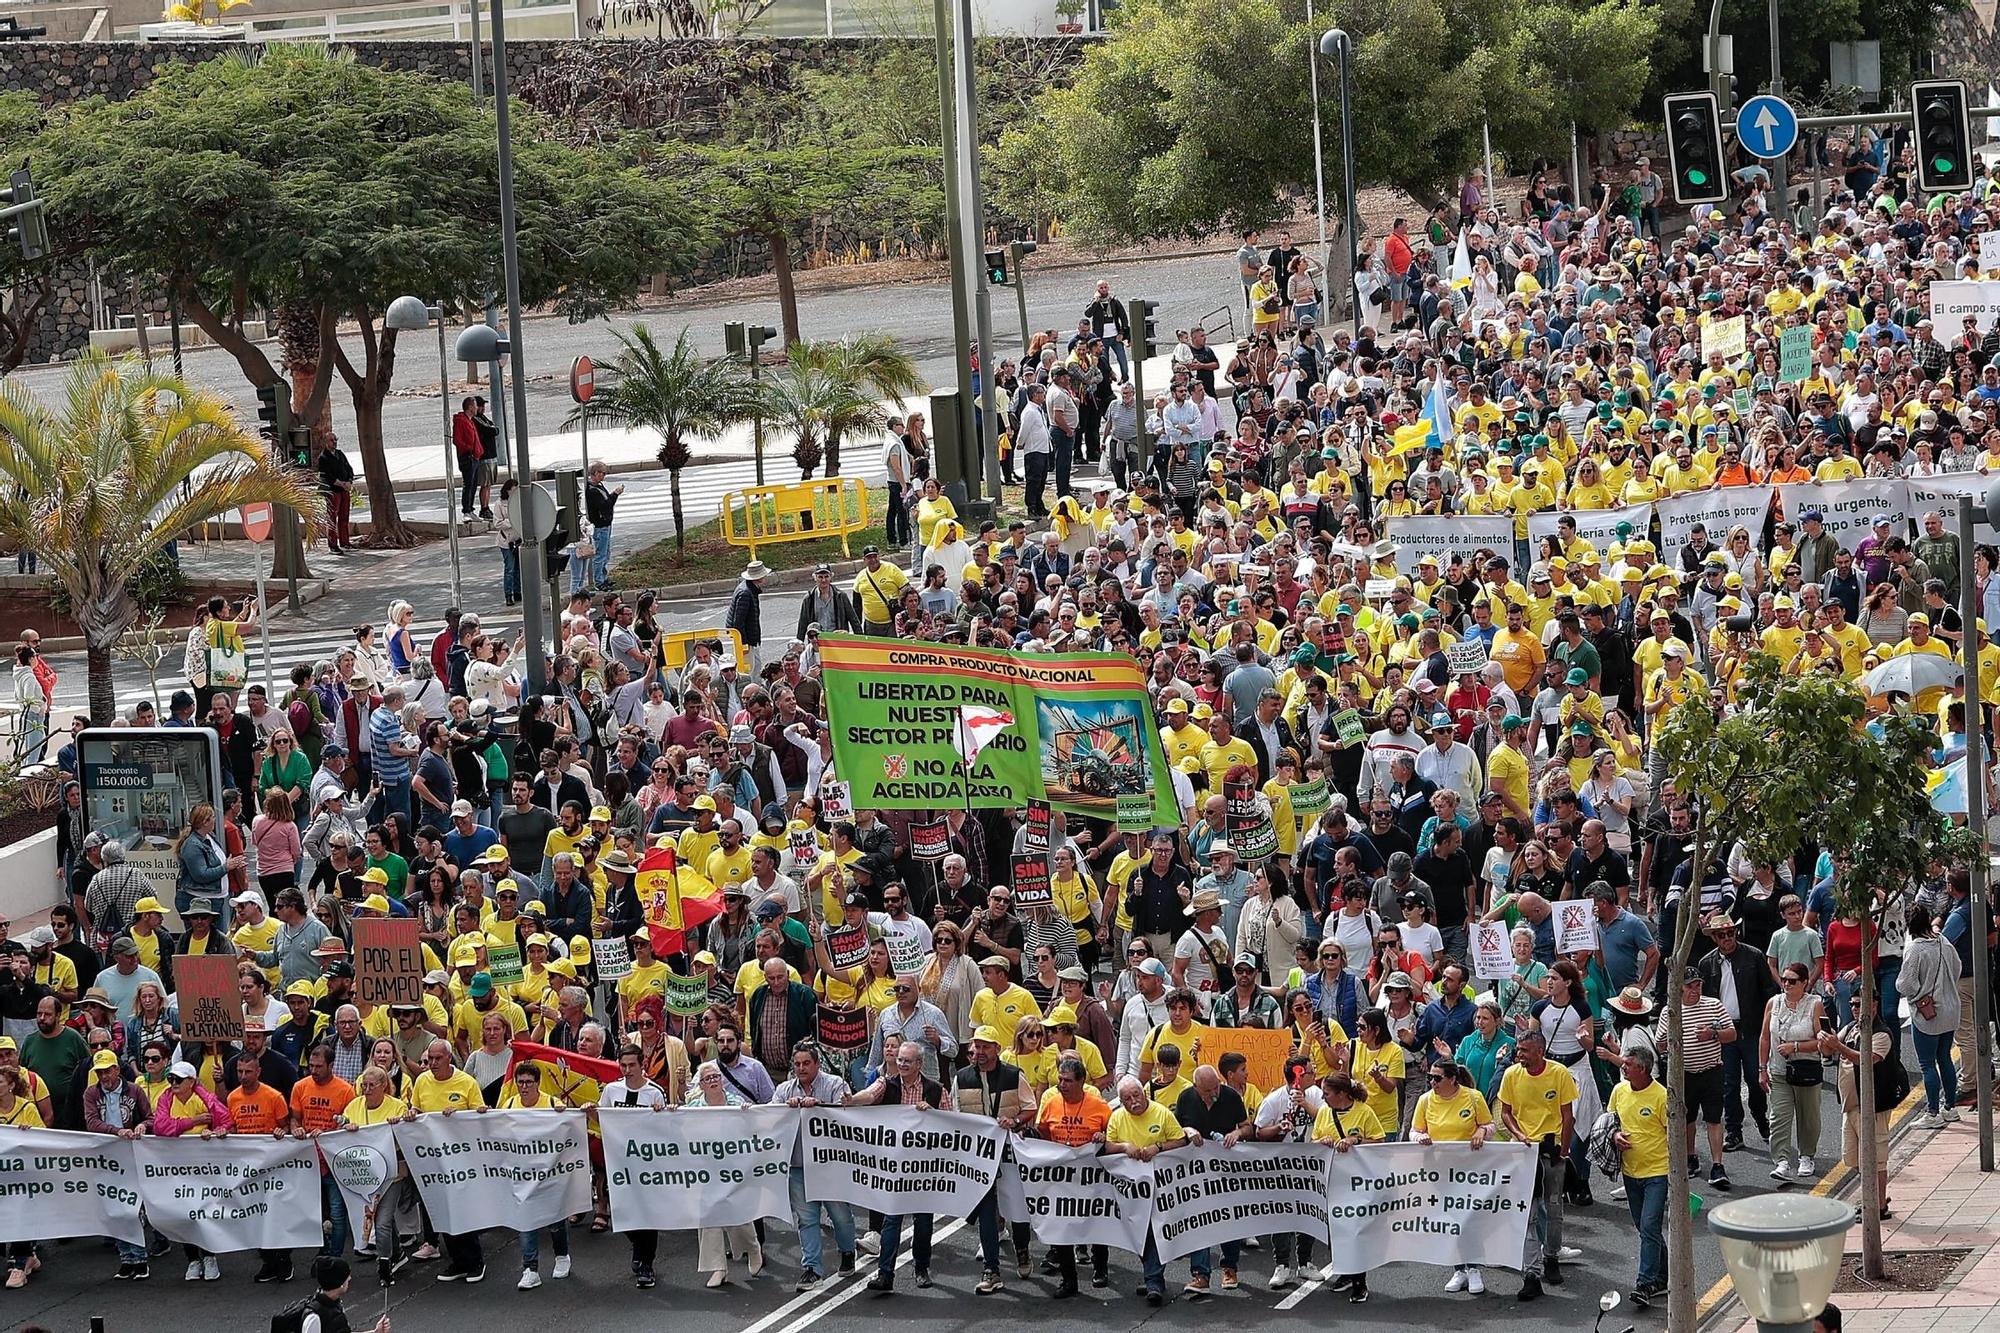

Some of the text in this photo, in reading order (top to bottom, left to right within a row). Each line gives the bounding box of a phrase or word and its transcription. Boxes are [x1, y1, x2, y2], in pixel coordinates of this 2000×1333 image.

[1934, 303, 1986, 314] El campo
[1834, 496, 1892, 513] urgente,
[1914, 491, 1936, 502] No
[1669, 508, 1730, 526] Protestamos
[1854, 516, 1870, 527] se
[1390, 533, 1510, 545] Productores de alimentos,
[1664, 536, 1676, 547] tu
[889, 651, 1096, 682] COMPRA PRODUCTO NACIONAL
[858, 682, 1010, 707] LIBERTAD PARA
[848, 726, 926, 744] SECTOR
[98, 766, 139, 775] Tacoronte
[913, 759, 945, 776] NO
[969, 763, 996, 779] LA
[872, 781, 1013, 800] AGENDA 2030
[824, 800, 840, 811] NO
[1028, 808, 1049, 823] SIN
[912, 834, 946, 845] TRAIDOR
[1027, 833, 1048, 846] VIDA
[795, 847, 814, 858] NO
[1015, 862, 1046, 878] SIN
[1024, 876, 1048, 884] CAMPO
[1017, 890, 1050, 901] VIDA
[363, 947, 419, 973] POR EL
[362, 976, 420, 1001] CAMPO
[667, 979, 706, 993] PRECIOS
[198, 997, 221, 1009] QUE
[675, 996, 706, 1008] CAMPO
[193, 1008, 231, 1023] SOBRAN
[820, 1020, 865, 1032] GOBIERNO
[820, 1030, 866, 1042] TRAIDOR
[240, 1104, 259, 1114] SIN
[309, 1097, 330, 1106] SIN
[1061, 1116, 1083, 1125] SIN
[414, 1137, 578, 1158] Costes inasumibles,
[626, 1134, 781, 1161] Agua urgente,
[809, 1117, 997, 1160] Cláusula espejo YA
[345, 1148, 370, 1159] NO AL
[34, 1154, 125, 1175] urgente,
[144, 1162, 221, 1178] Burocracia
[225, 1163, 239, 1177] de
[420, 1159, 585, 1188] precios insuficientes
[812, 1147, 989, 1186] Igualdad de condiciones
[1018, 1163, 1076, 1182] ector
[1154, 1168, 1173, 1188] No
[1176, 1164, 1186, 1180] a
[1209, 1156, 1326, 1174] especulación
[612, 1161, 788, 1188] el campo se sec
[852, 1169, 956, 1193] de producción
[1350, 1168, 1440, 1191] Producto
[1448, 1168, 1496, 1186] local
[64, 1180, 138, 1206] se seca
[174, 1176, 284, 1200] sin poner un pie
[1156, 1175, 1327, 1213] de los intermediarios
[189, 1201, 268, 1220] en el campo
[1026, 1196, 1050, 1215] se
[1331, 1192, 1422, 1219] economía
[1443, 1194, 1512, 1214] paisaje
[1162, 1200, 1329, 1241] Queremos precios justos
[1391, 1216, 1461, 1236] cultura
